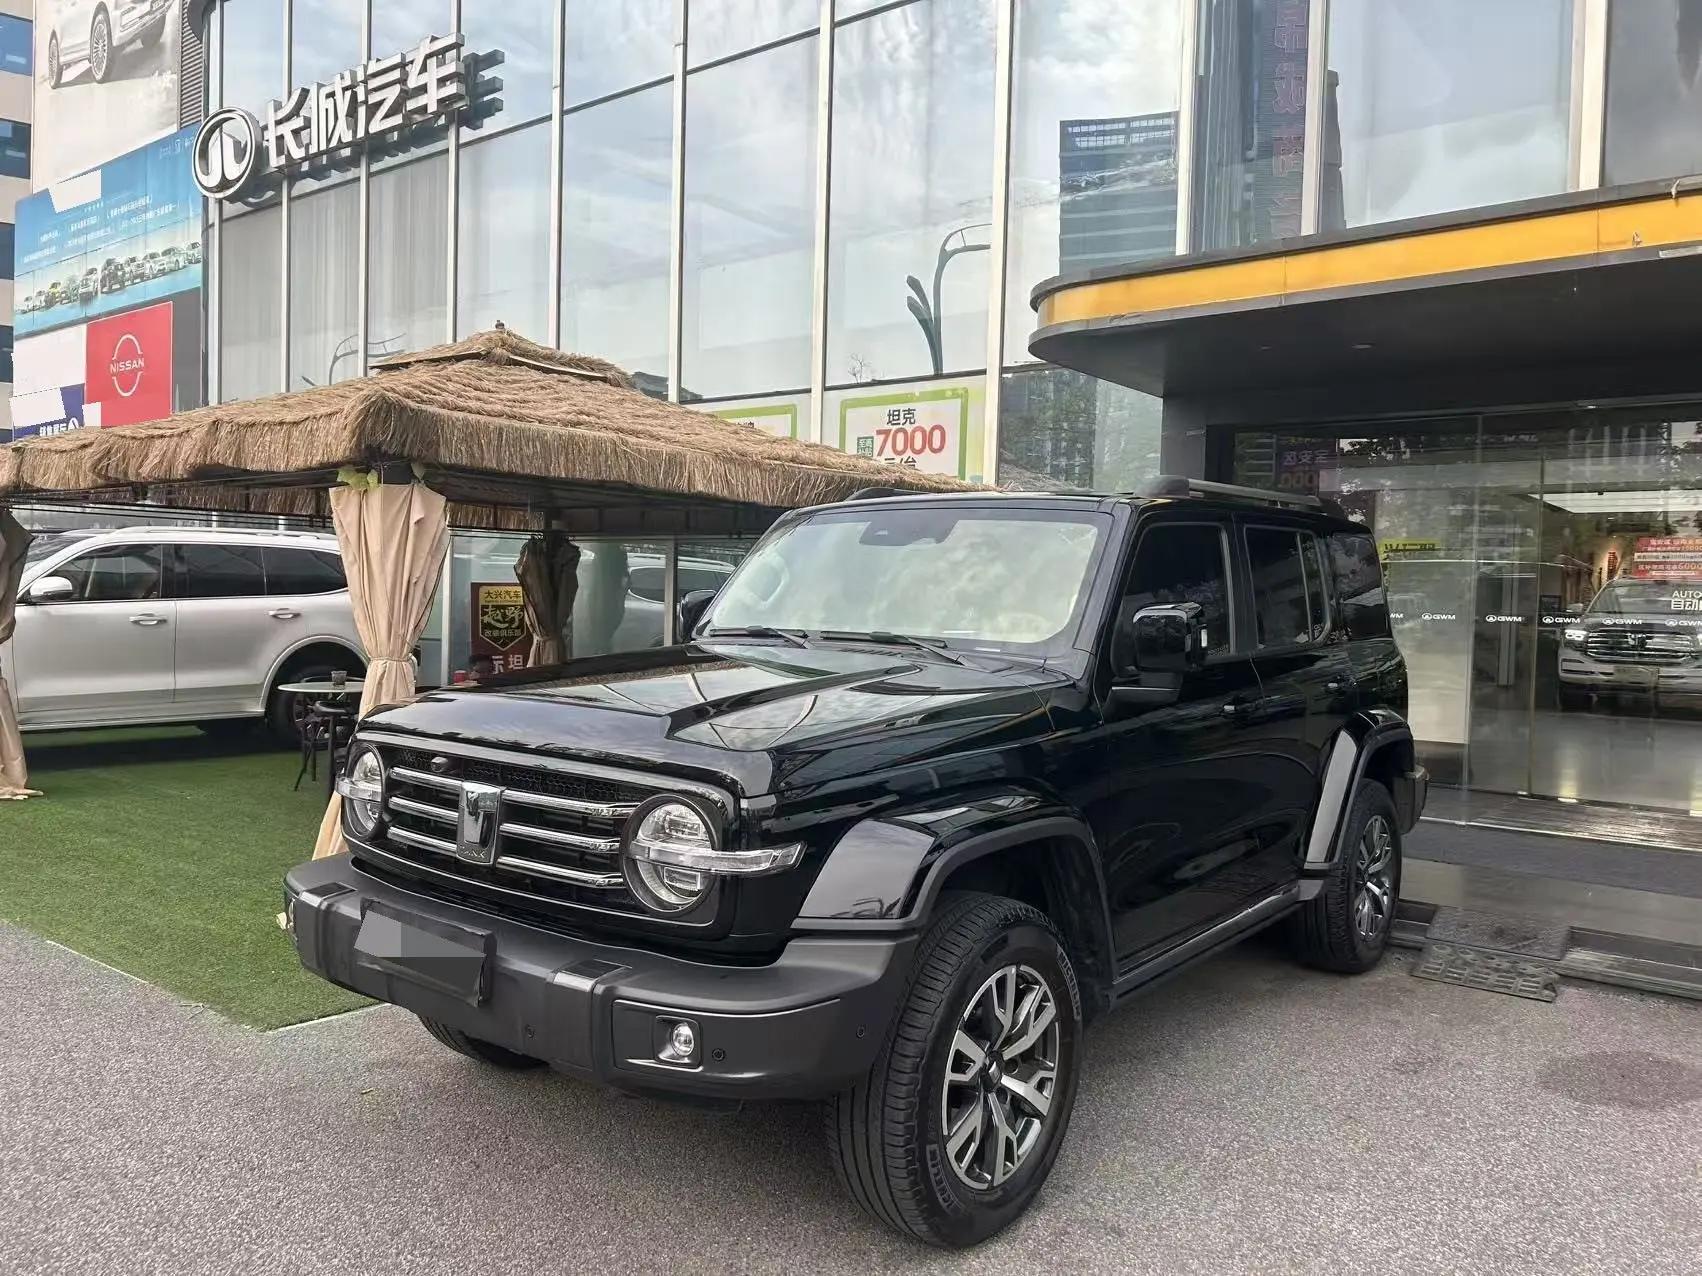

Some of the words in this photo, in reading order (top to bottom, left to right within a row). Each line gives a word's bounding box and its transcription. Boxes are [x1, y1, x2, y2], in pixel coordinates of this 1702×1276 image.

[263, 32, 463, 168] 长城汽车
[110, 358, 144, 373] NISSAN
[886, 408, 916, 426] 坦克
[876, 424, 946, 457] 7000
[485, 590, 522, 599] 大兴汽车
[1671, 599, 1702, 611] 自动
